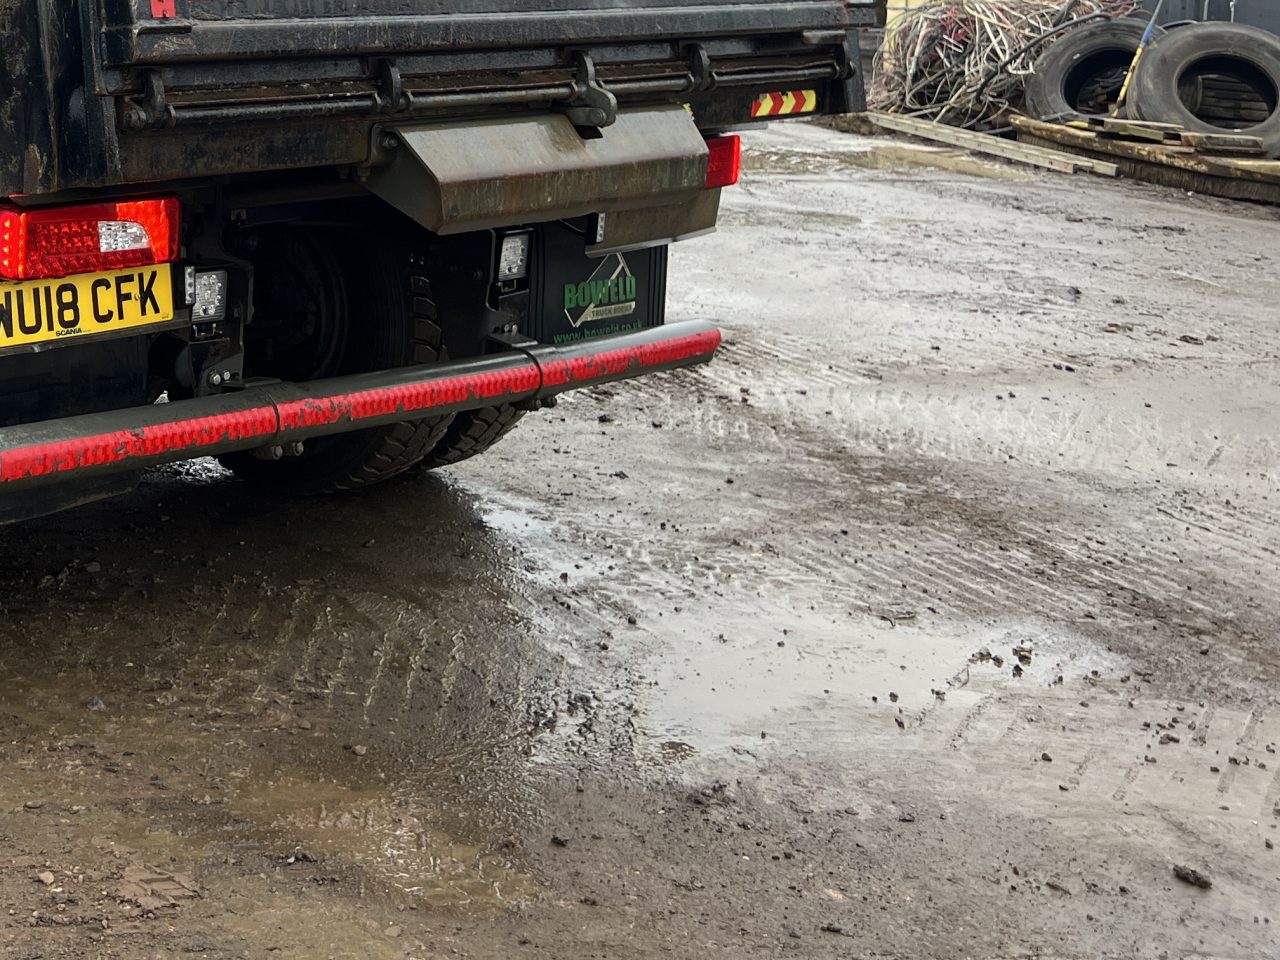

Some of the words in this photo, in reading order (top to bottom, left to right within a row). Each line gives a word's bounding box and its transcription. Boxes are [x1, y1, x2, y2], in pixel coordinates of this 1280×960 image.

[91, 270, 161, 324] CFK
[564, 276, 636, 309] BOWELD
[55, 327, 83, 337] SCANIA
